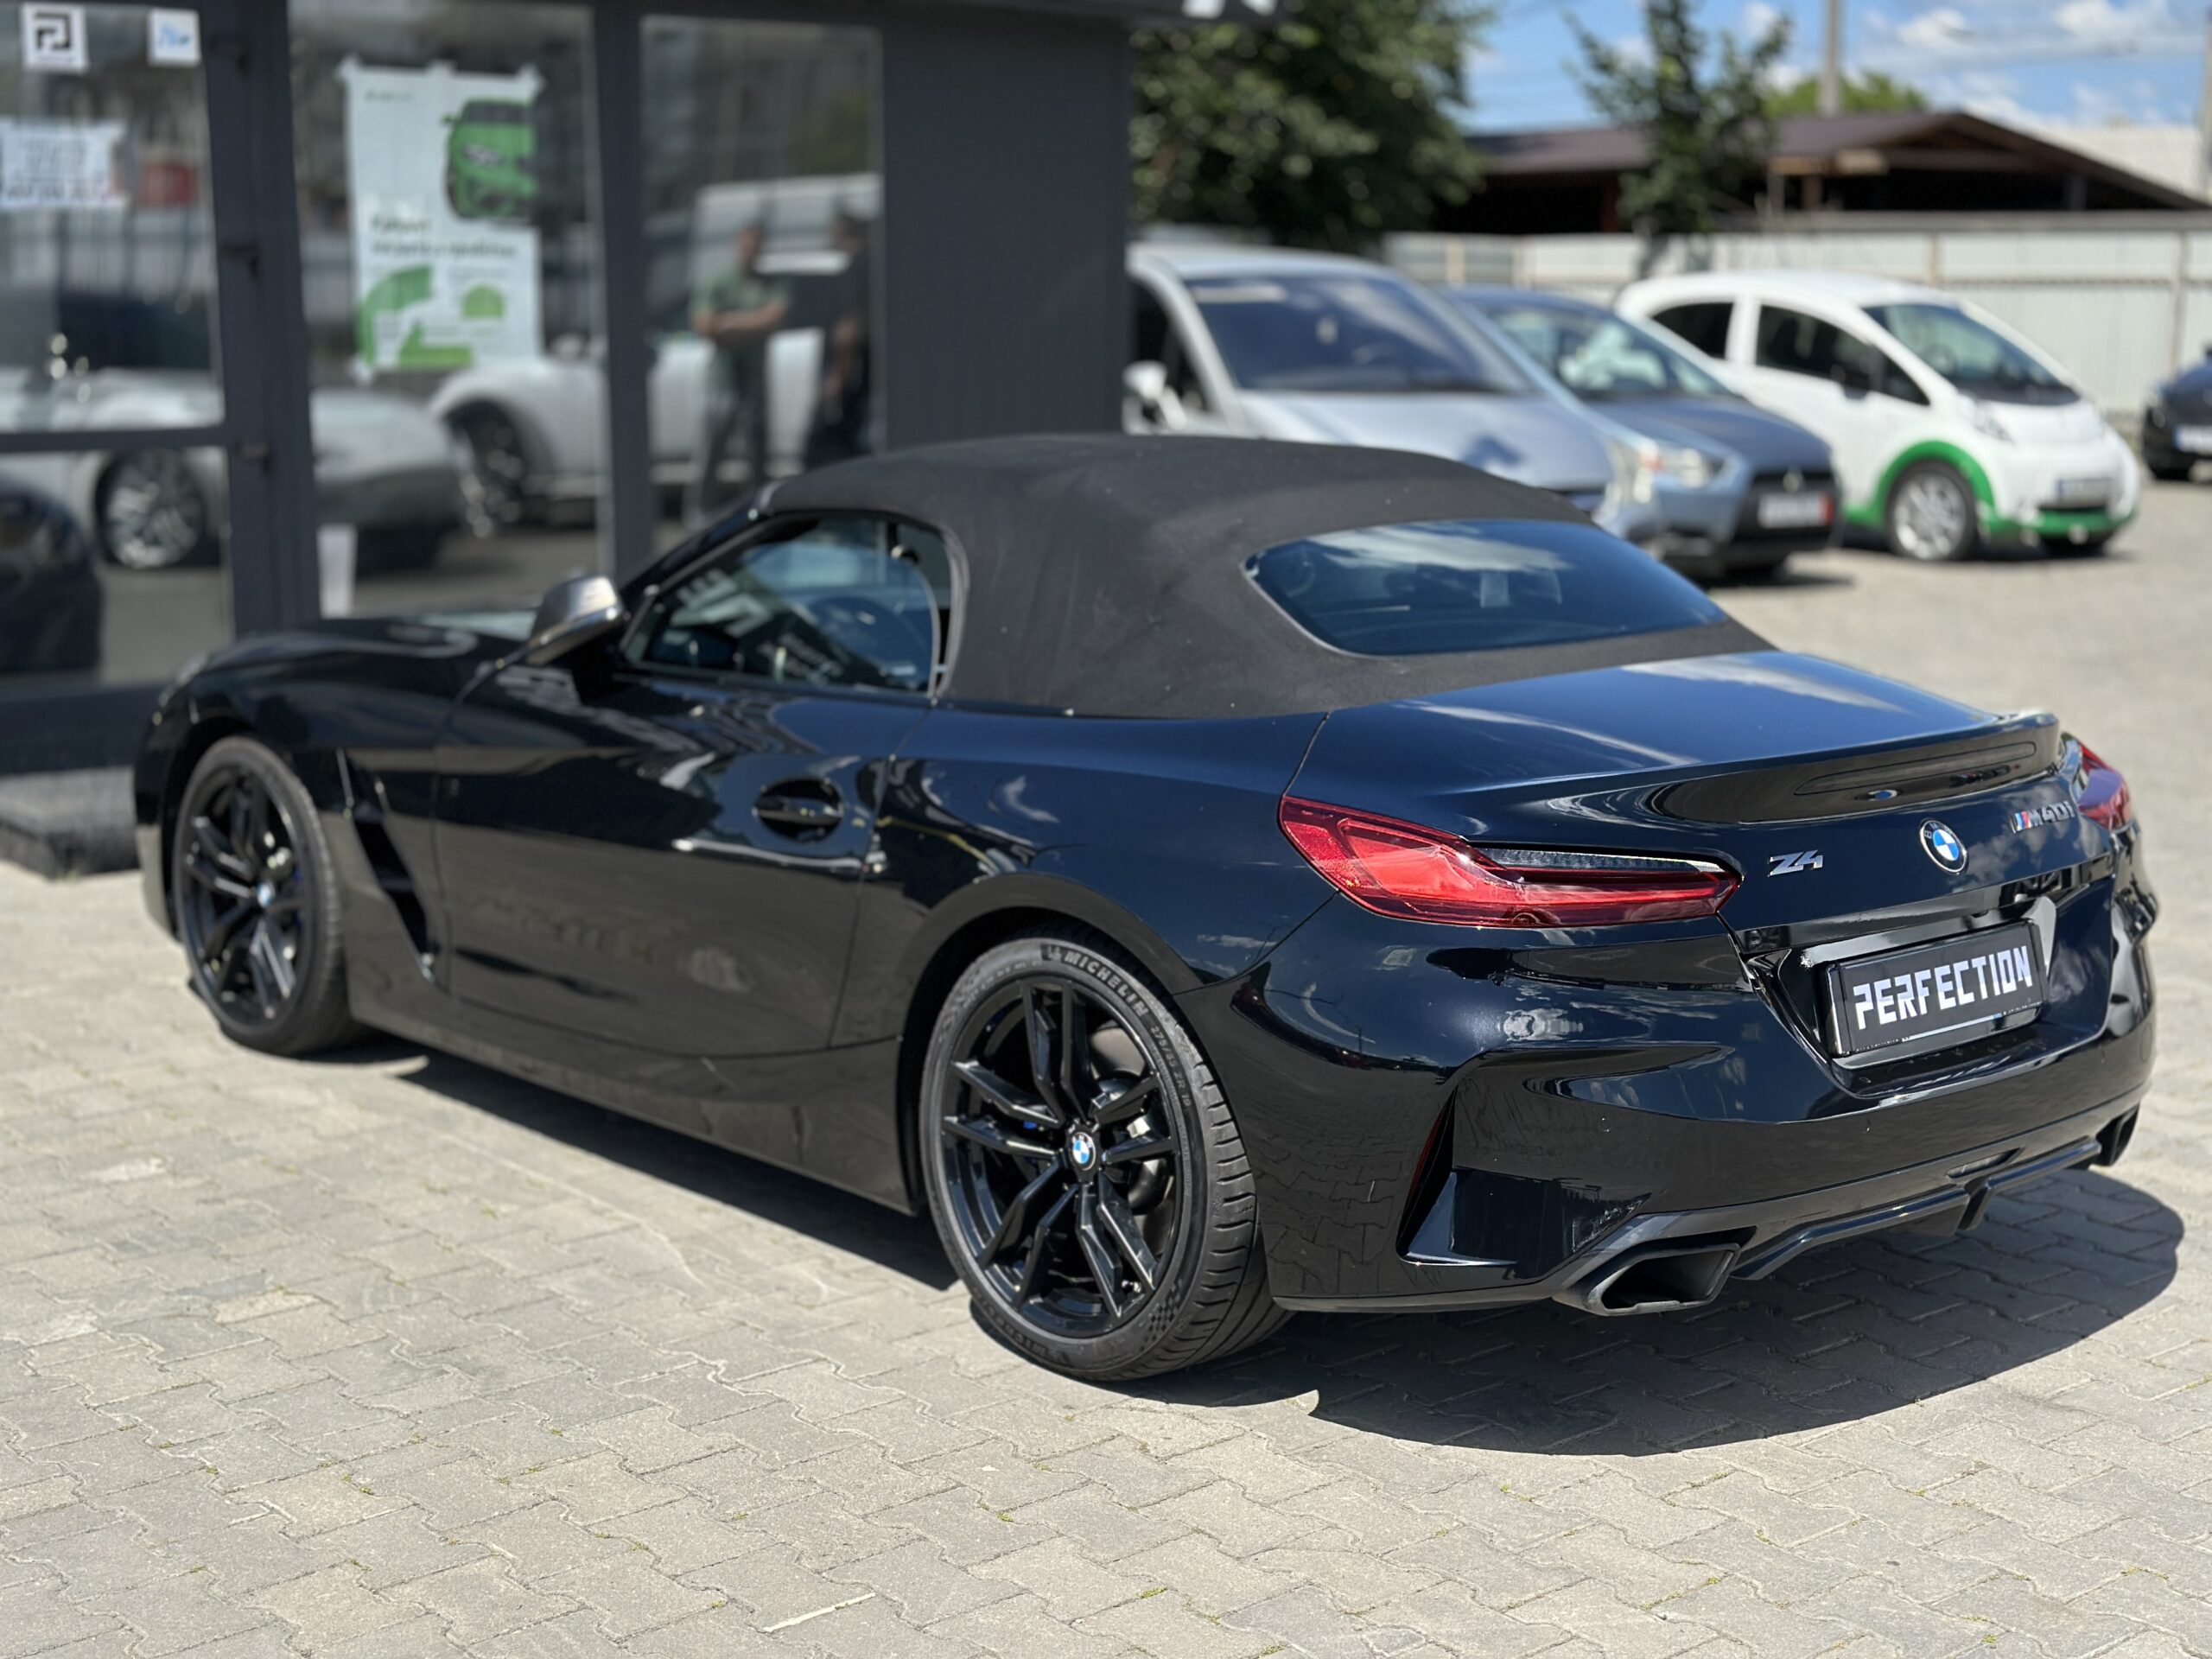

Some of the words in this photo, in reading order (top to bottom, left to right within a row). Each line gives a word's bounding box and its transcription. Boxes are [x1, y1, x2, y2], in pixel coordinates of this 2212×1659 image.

[1768, 849, 1823, 877] Z4
[1065, 950, 1149, 1017] MICHELIN
[1853, 945, 2033, 1031] PERFECTION
